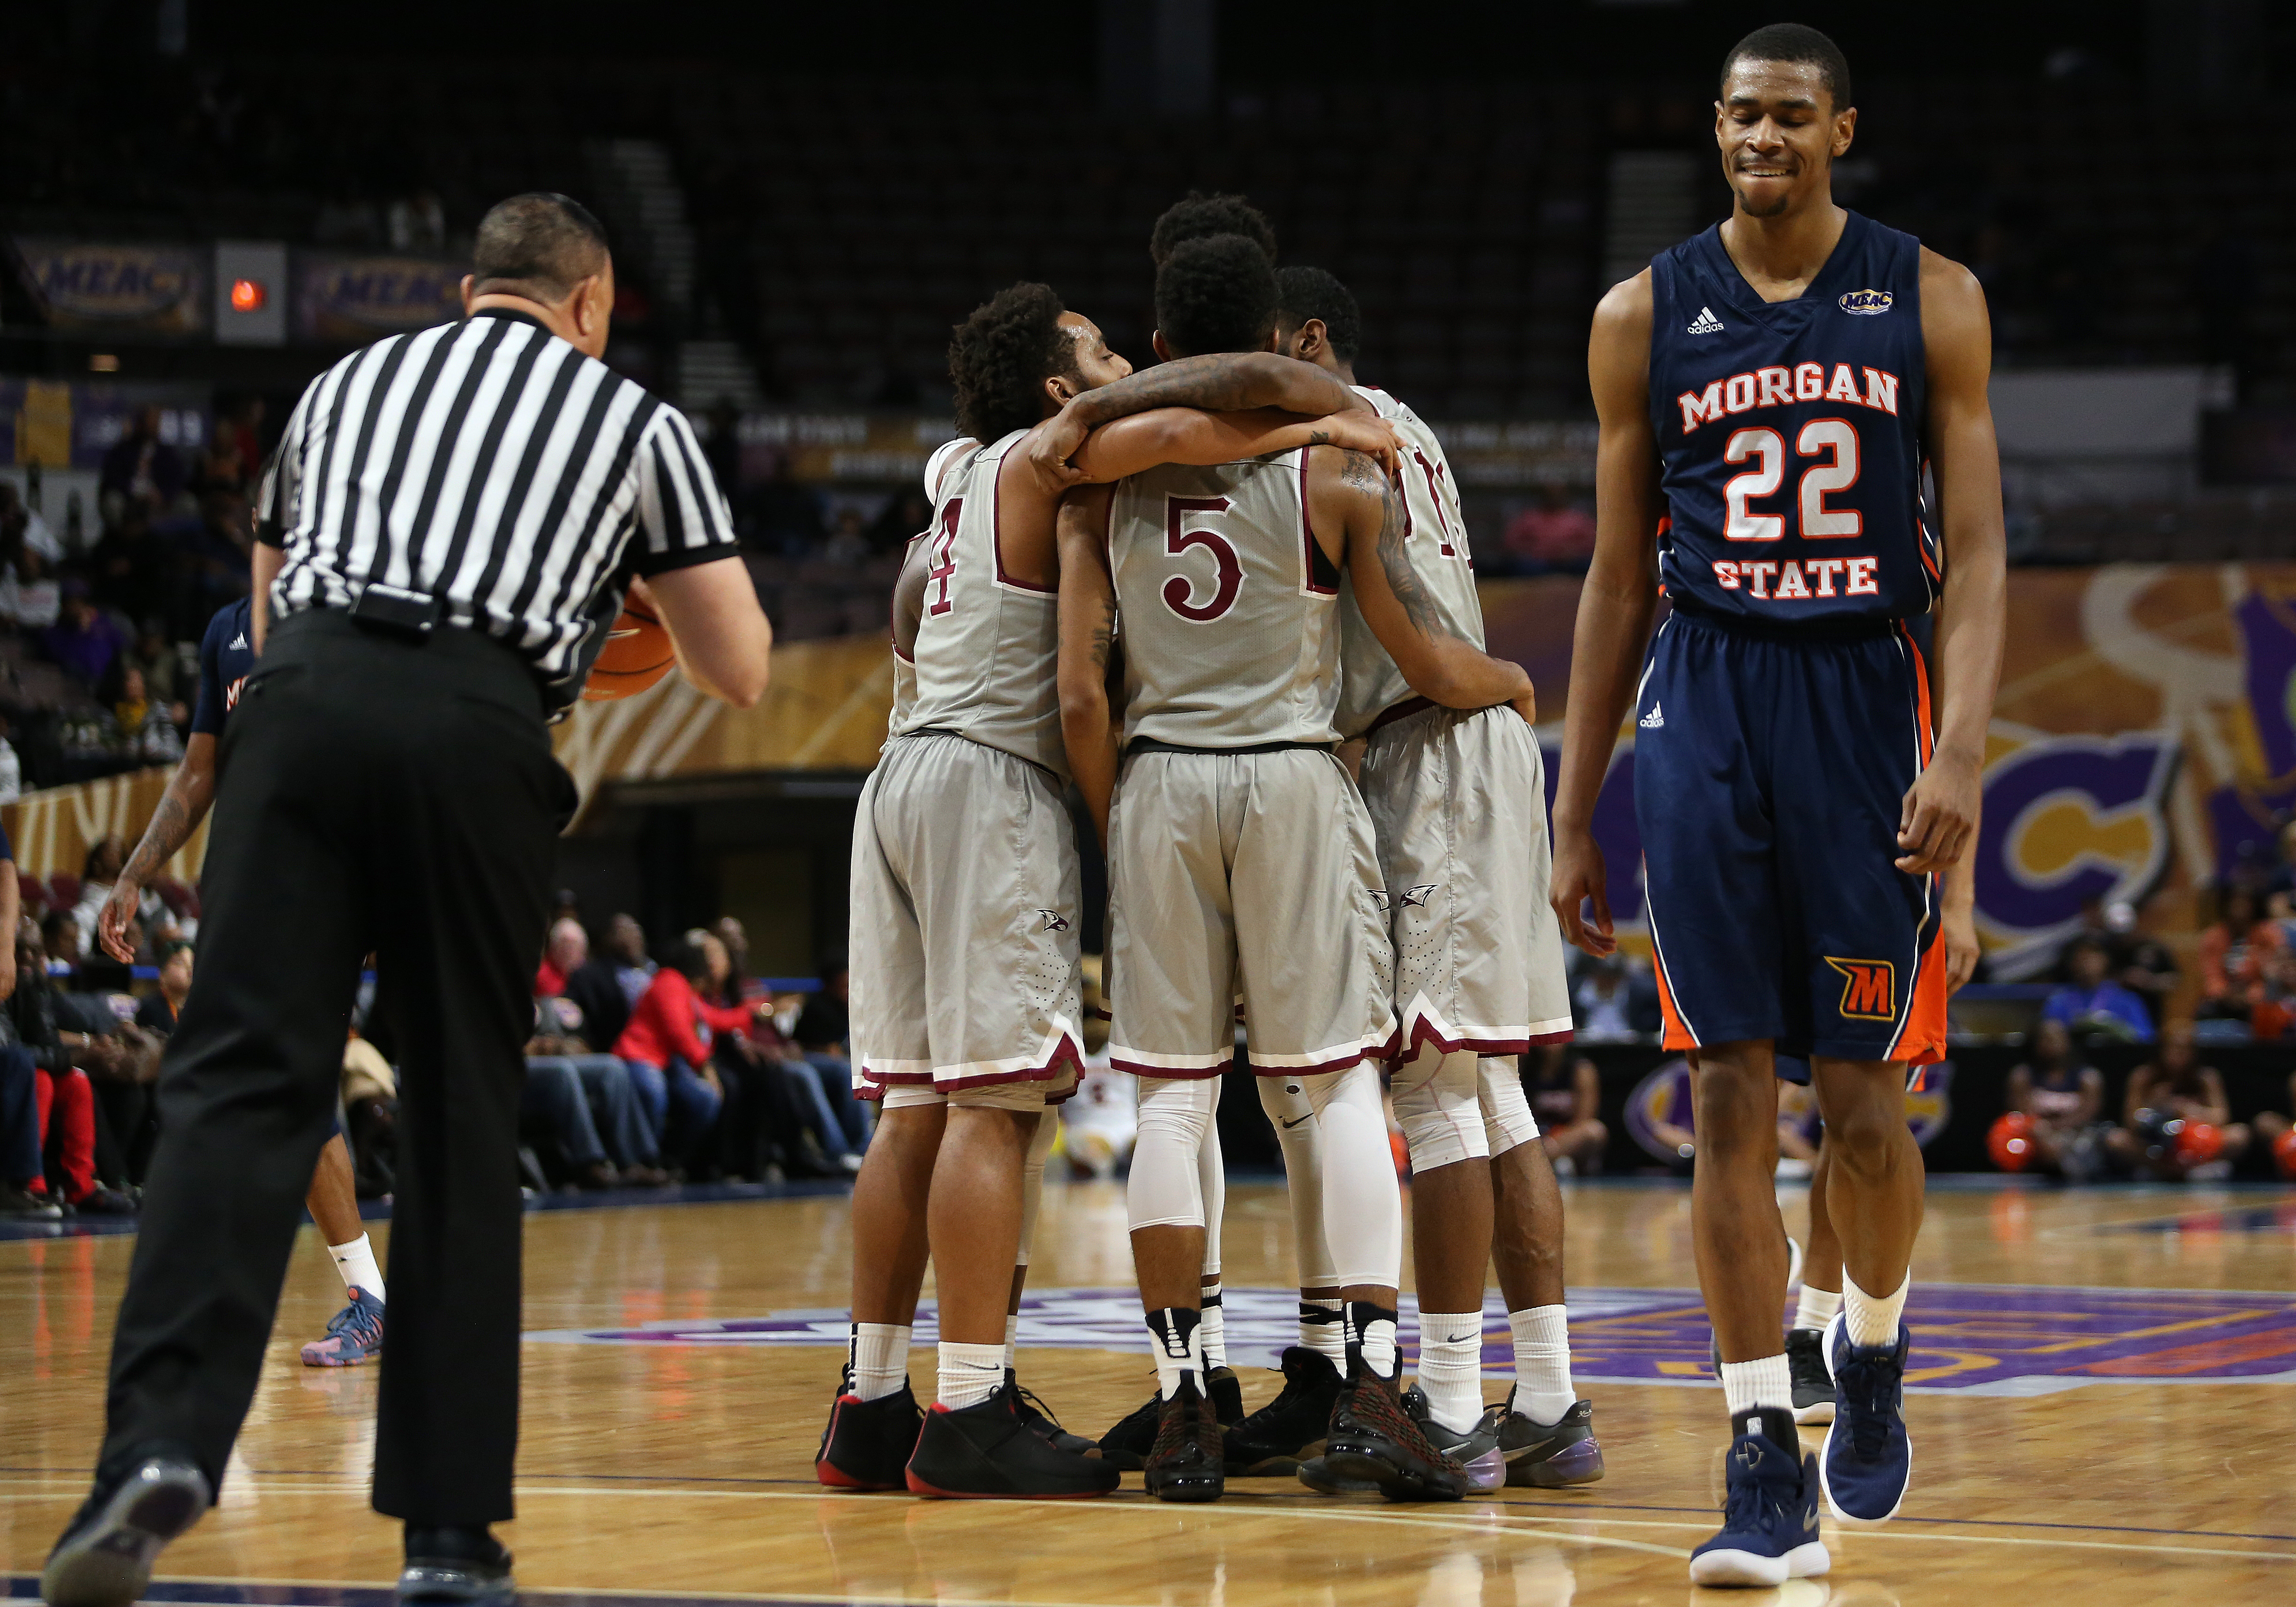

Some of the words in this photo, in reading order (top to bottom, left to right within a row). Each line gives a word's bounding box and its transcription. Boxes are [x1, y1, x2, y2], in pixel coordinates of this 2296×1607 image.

[1687, 322, 1725, 335] adidas
[1840, 291, 1892, 308] MEAC
[1678, 362, 1899, 434] MORGAN
[1724, 417, 1862, 541] 22
[928, 493, 967, 620] 4
[1161, 492, 1247, 625] 5
[1712, 556, 1878, 599] STATE
[1845, 965, 1889, 1015] M
